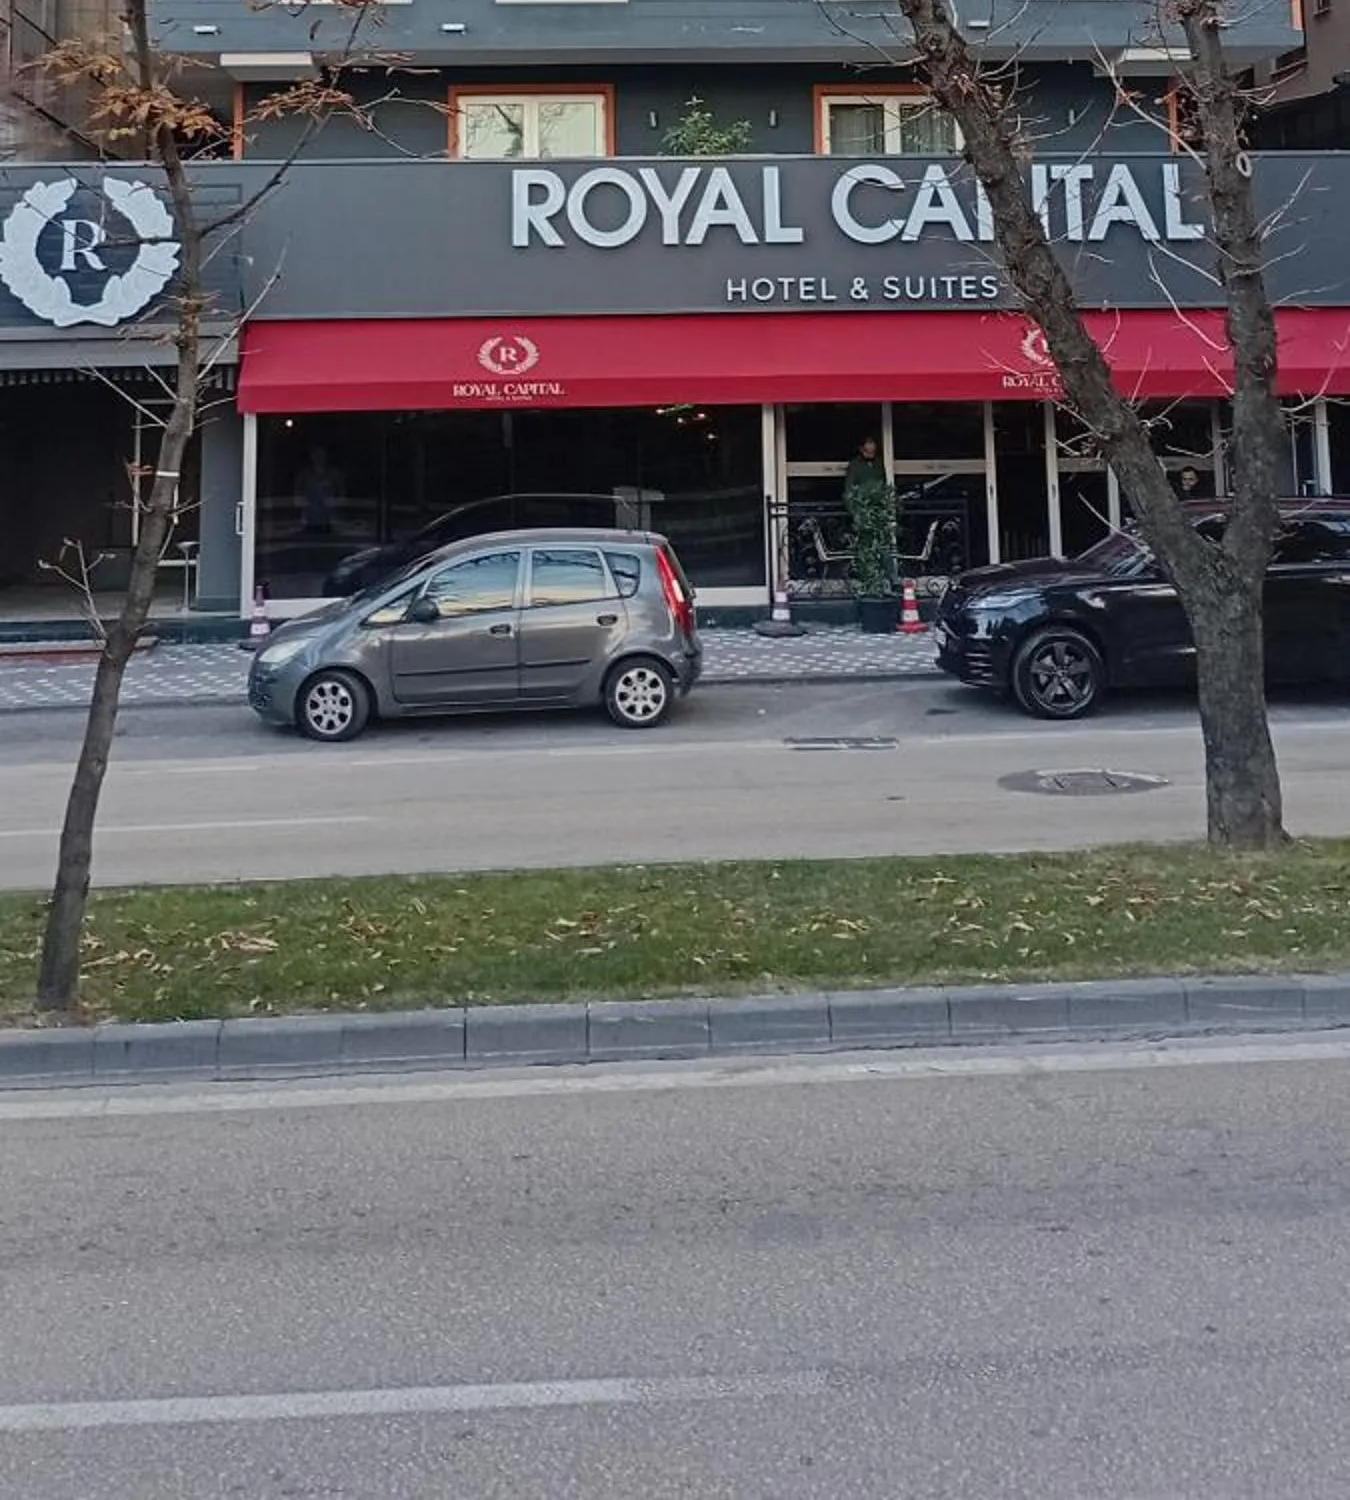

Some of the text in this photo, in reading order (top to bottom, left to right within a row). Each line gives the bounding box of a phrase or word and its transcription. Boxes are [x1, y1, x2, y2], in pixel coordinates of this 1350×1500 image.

[511, 166, 804, 248] ROYAL
[59, 219, 108, 271] R
[726, 275, 999, 301] HOTEL & SUITES
[500, 347, 518, 361] R
[453, 383, 565, 397] ROYAL CAPITAL
